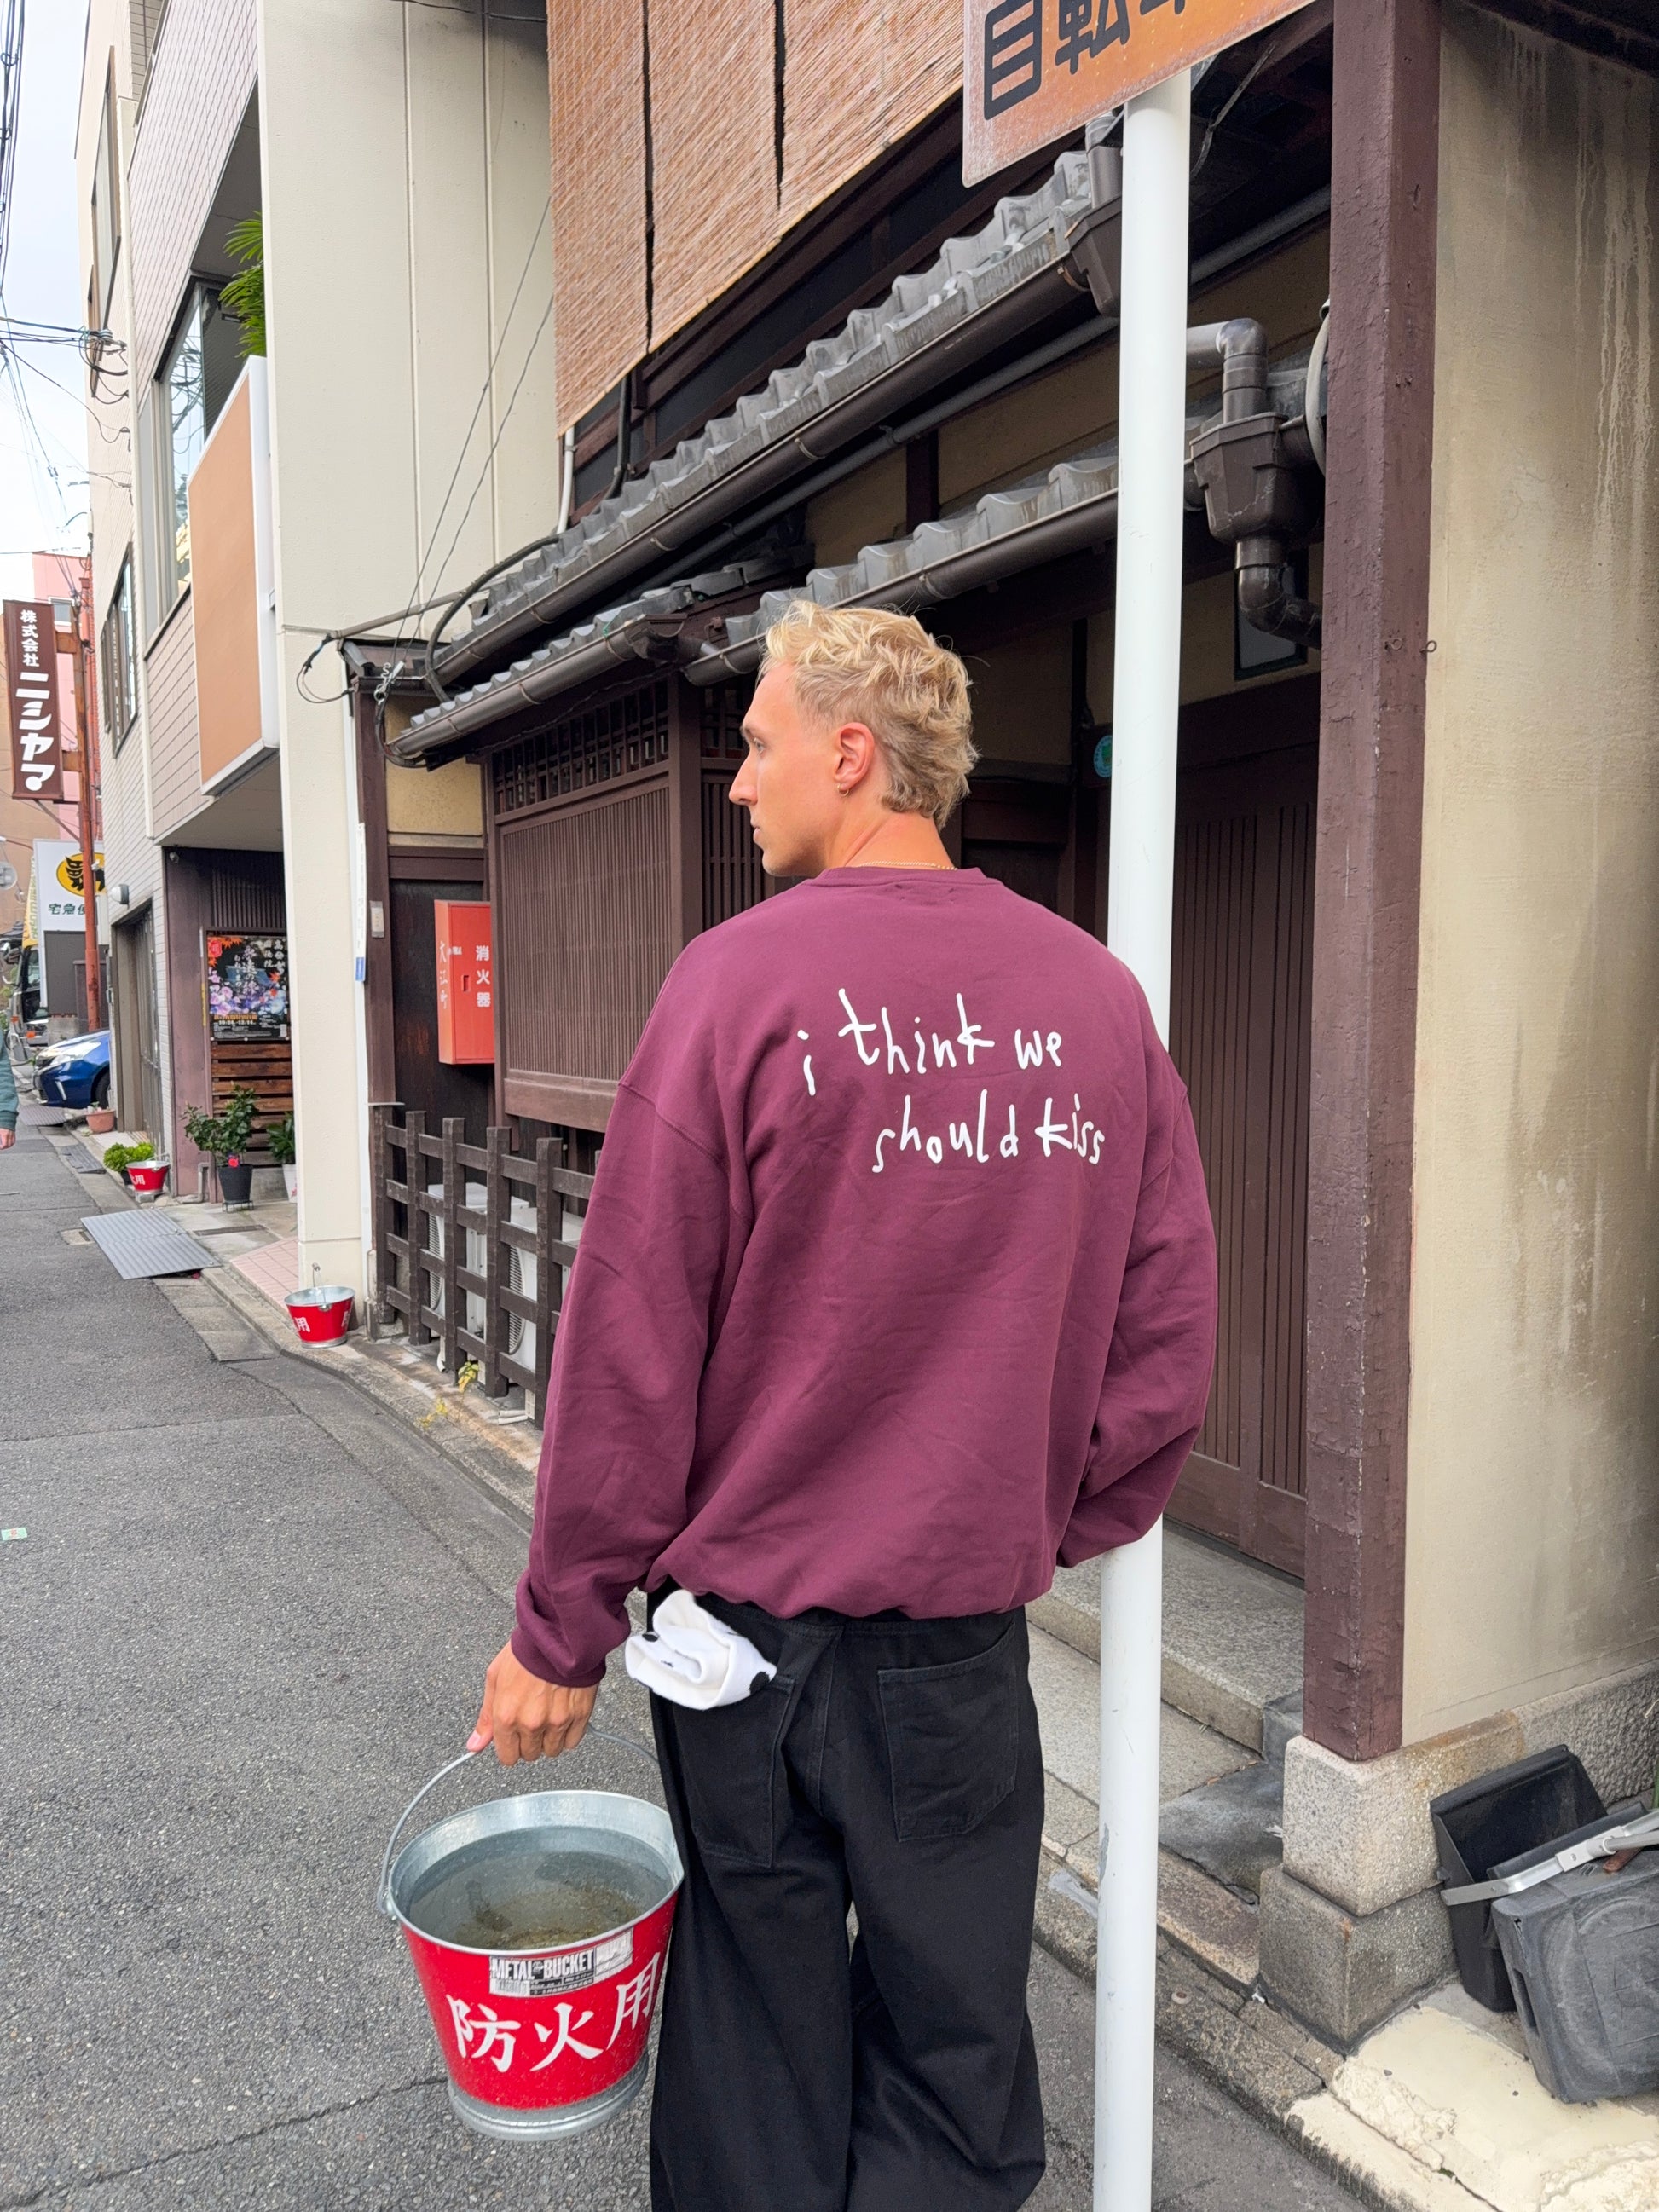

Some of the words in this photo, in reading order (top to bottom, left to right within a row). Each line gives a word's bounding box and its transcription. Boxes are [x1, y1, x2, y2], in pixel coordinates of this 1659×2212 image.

[984, 0, 1187, 121] 自転
[20, 609, 39, 667] 株式会社
[15, 671, 55, 792] ニシヤマ
[476, 944, 491, 1008] 消火器
[797, 1029, 816, 1096] i
[838, 988, 995, 1075] think
[1014, 1028, 1062, 1070] we
[872, 1089, 1020, 1174] should
[1034, 1093, 1106, 1165] kiss
[446, 1952, 661, 2073] 防火用
[490, 1957, 535, 1980] METAL
[543, 1949, 594, 1979] BUCKET
